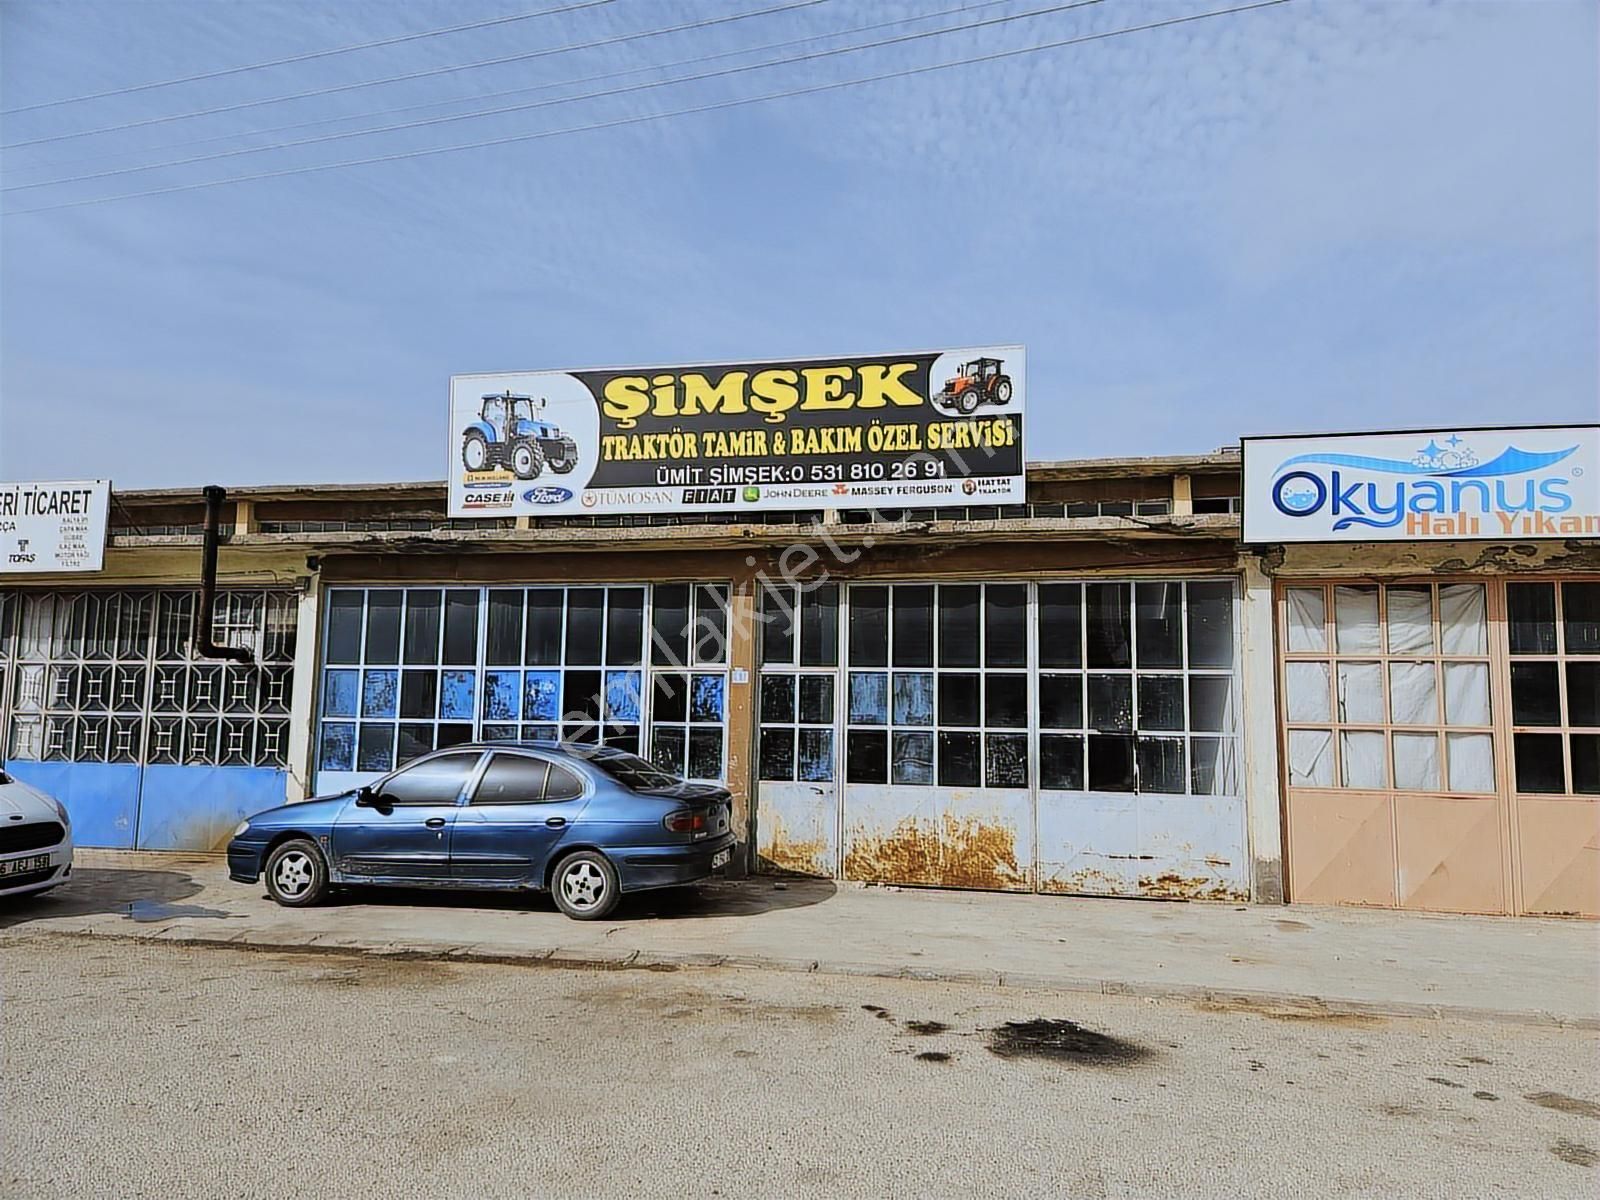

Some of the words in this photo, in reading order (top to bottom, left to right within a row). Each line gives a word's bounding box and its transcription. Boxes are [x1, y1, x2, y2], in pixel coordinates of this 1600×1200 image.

[602, 362, 924, 430] ŞiMŞEK
[602, 427, 698, 461] TRAKTÖR
[773, 431, 786, 456] &
[790, 426, 862, 455] BAKIM
[867, 418, 922, 453] ÖZEL
[655, 465, 701, 485] ÜMİT
[811, 464, 843, 481] 531
[850, 462, 883, 480] 810
[891, 461, 917, 478] 26
[925, 460, 945, 477] 91
[978, 478, 1010, 486] HATTAT
[0, 485, 19, 515] Rİ
[24, 484, 92, 515] TİCARET
[465, 493, 501, 503] CASE
[531, 486, 565, 503] Ford
[599, 489, 672, 505] TÜMOSAN
[684, 489, 735, 503] FIAT
[851, 486, 892, 496] MASSEY
[895, 484, 953, 495] FERGUSON
[1272, 470, 1573, 531] Okyanus
[1406, 511, 1479, 536] Halı
